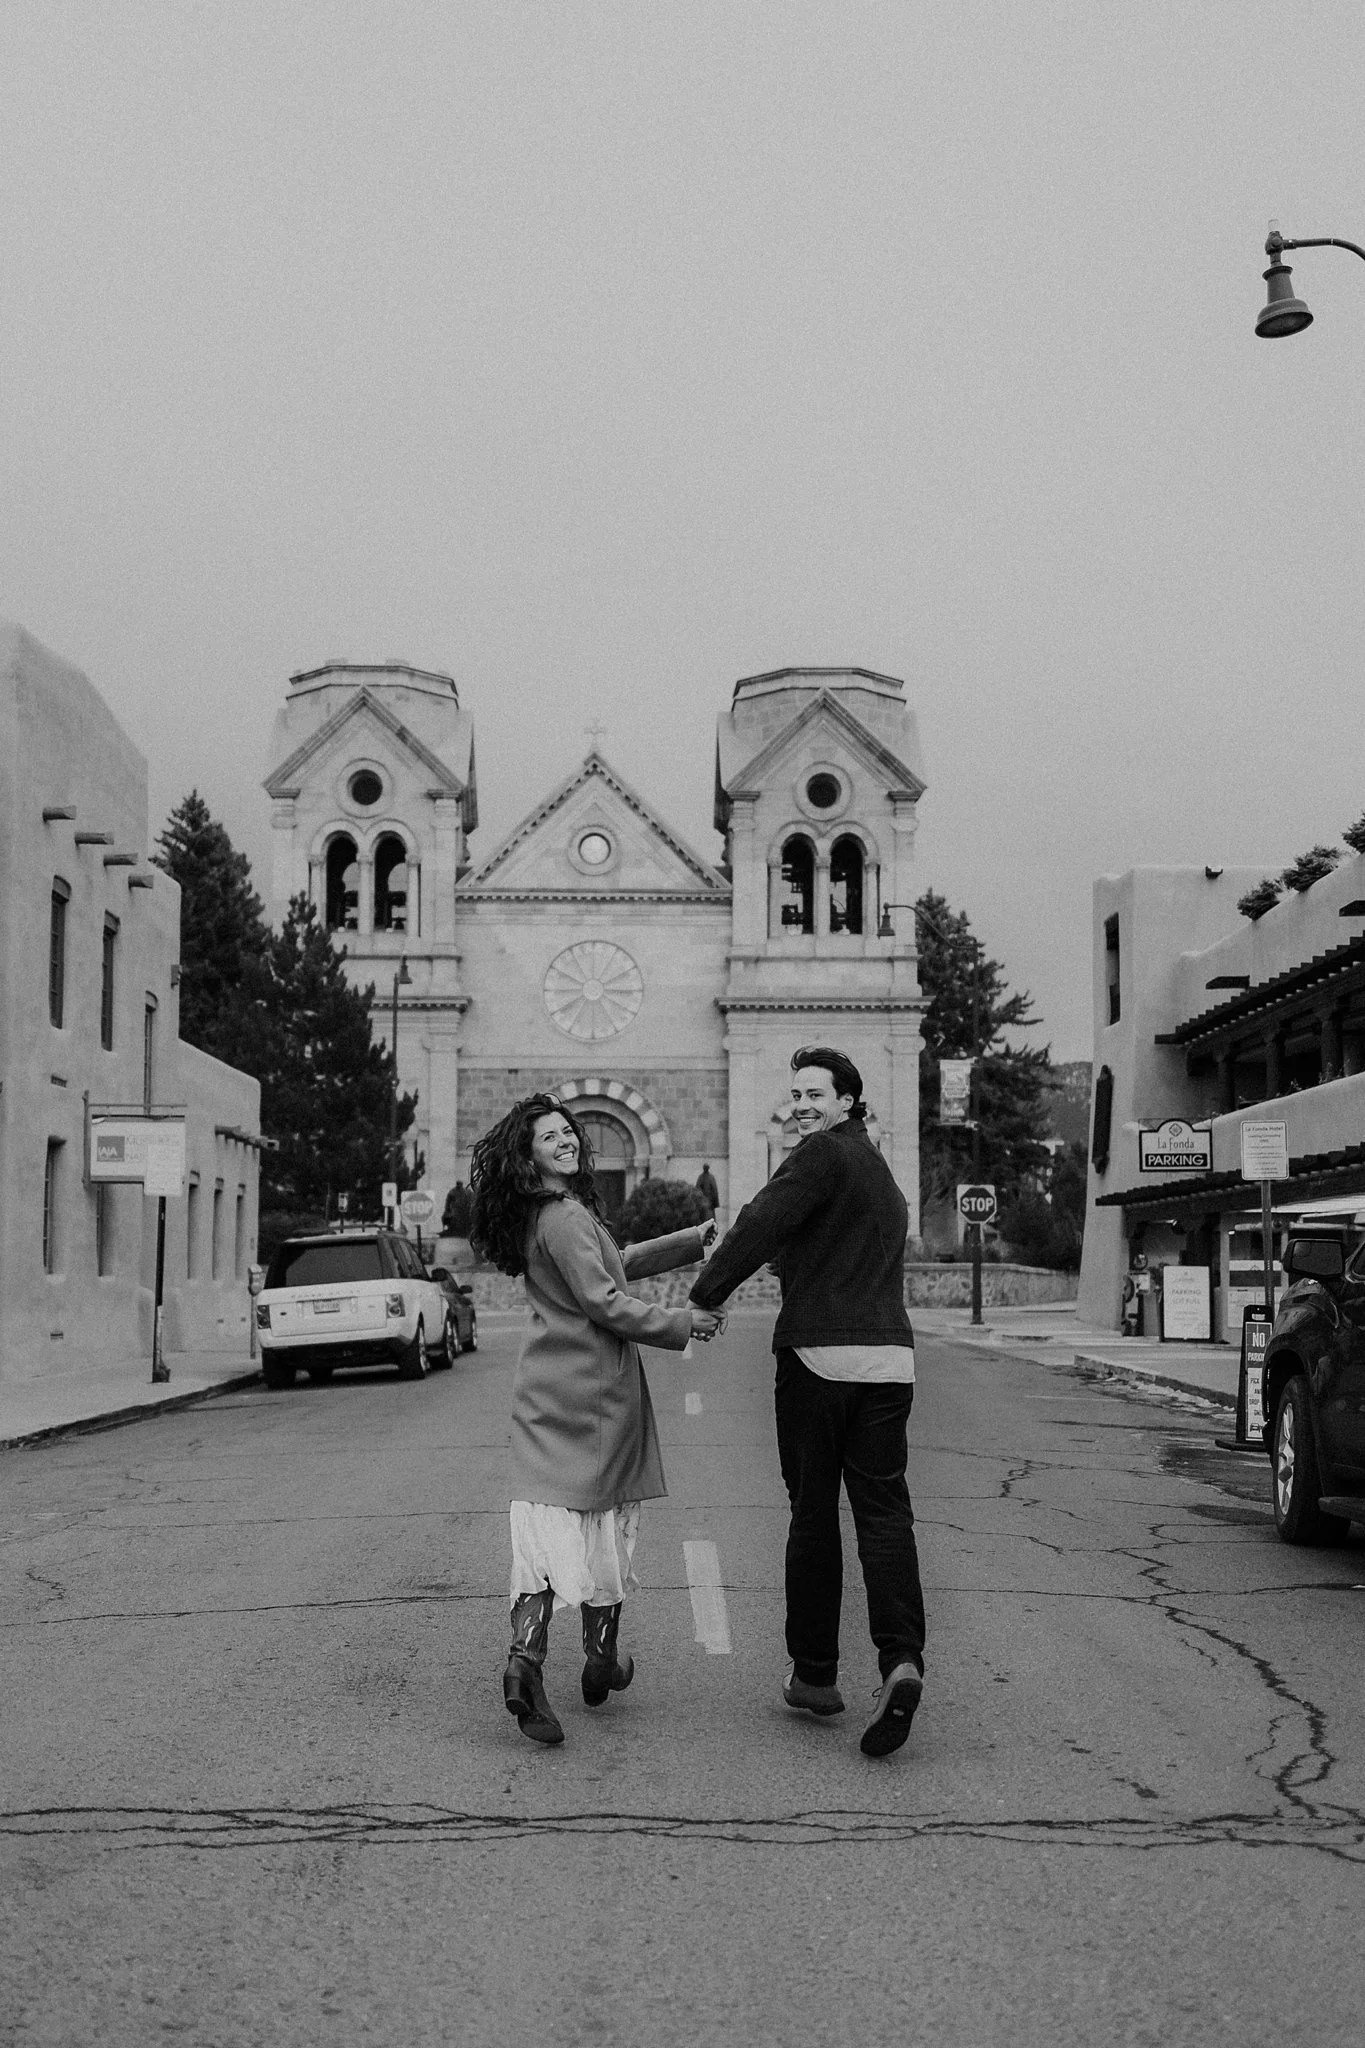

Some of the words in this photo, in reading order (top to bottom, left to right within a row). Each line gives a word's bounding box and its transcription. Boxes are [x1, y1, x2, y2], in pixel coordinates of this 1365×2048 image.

[1148, 1154, 1204, 1166] PARKING
[404, 1200, 433, 1214] STOP
[961, 1197, 994, 1212] STOP
[1252, 1332, 1265, 1347] NO
[1247, 1352, 1264, 1361] PARKI
